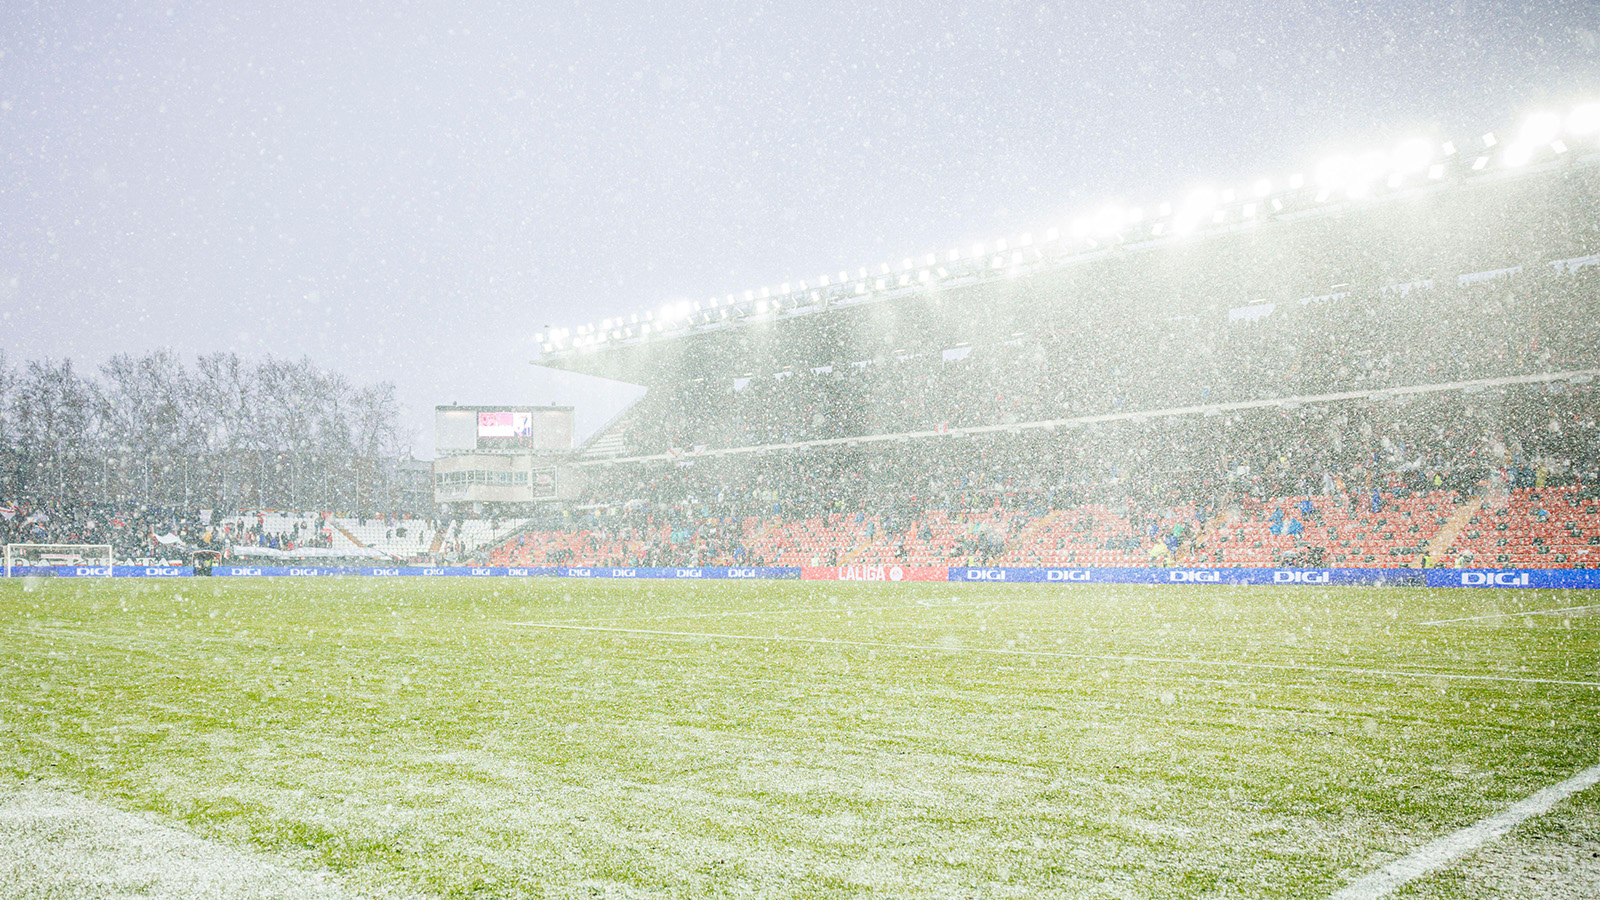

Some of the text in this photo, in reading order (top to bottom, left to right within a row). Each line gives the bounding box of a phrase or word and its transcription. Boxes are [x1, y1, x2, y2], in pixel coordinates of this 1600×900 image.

[76, 567, 110, 576] DIGI
[146, 567, 178, 576] DIGI
[231, 568, 261, 576] DIGI
[290, 568, 318, 576] DIGI
[373, 568, 399, 576] DIGI
[423, 567, 444, 576] DIGI
[471, 567, 491, 576] DIGI
[508, 568, 528, 576] DIGI
[568, 568, 591, 577] DIGI
[612, 568, 636, 577] DIGI
[676, 569, 702, 578] DIGI
[727, 568, 756, 578] DIGI
[838, 567, 886, 582] LALIGA
[967, 569, 1006, 580] DIGI
[1047, 570, 1091, 581] DIGI
[1170, 571, 1220, 583] DIGI
[1273, 571, 1330, 583] DIGI
[1461, 572, 1530, 586] DIGI
